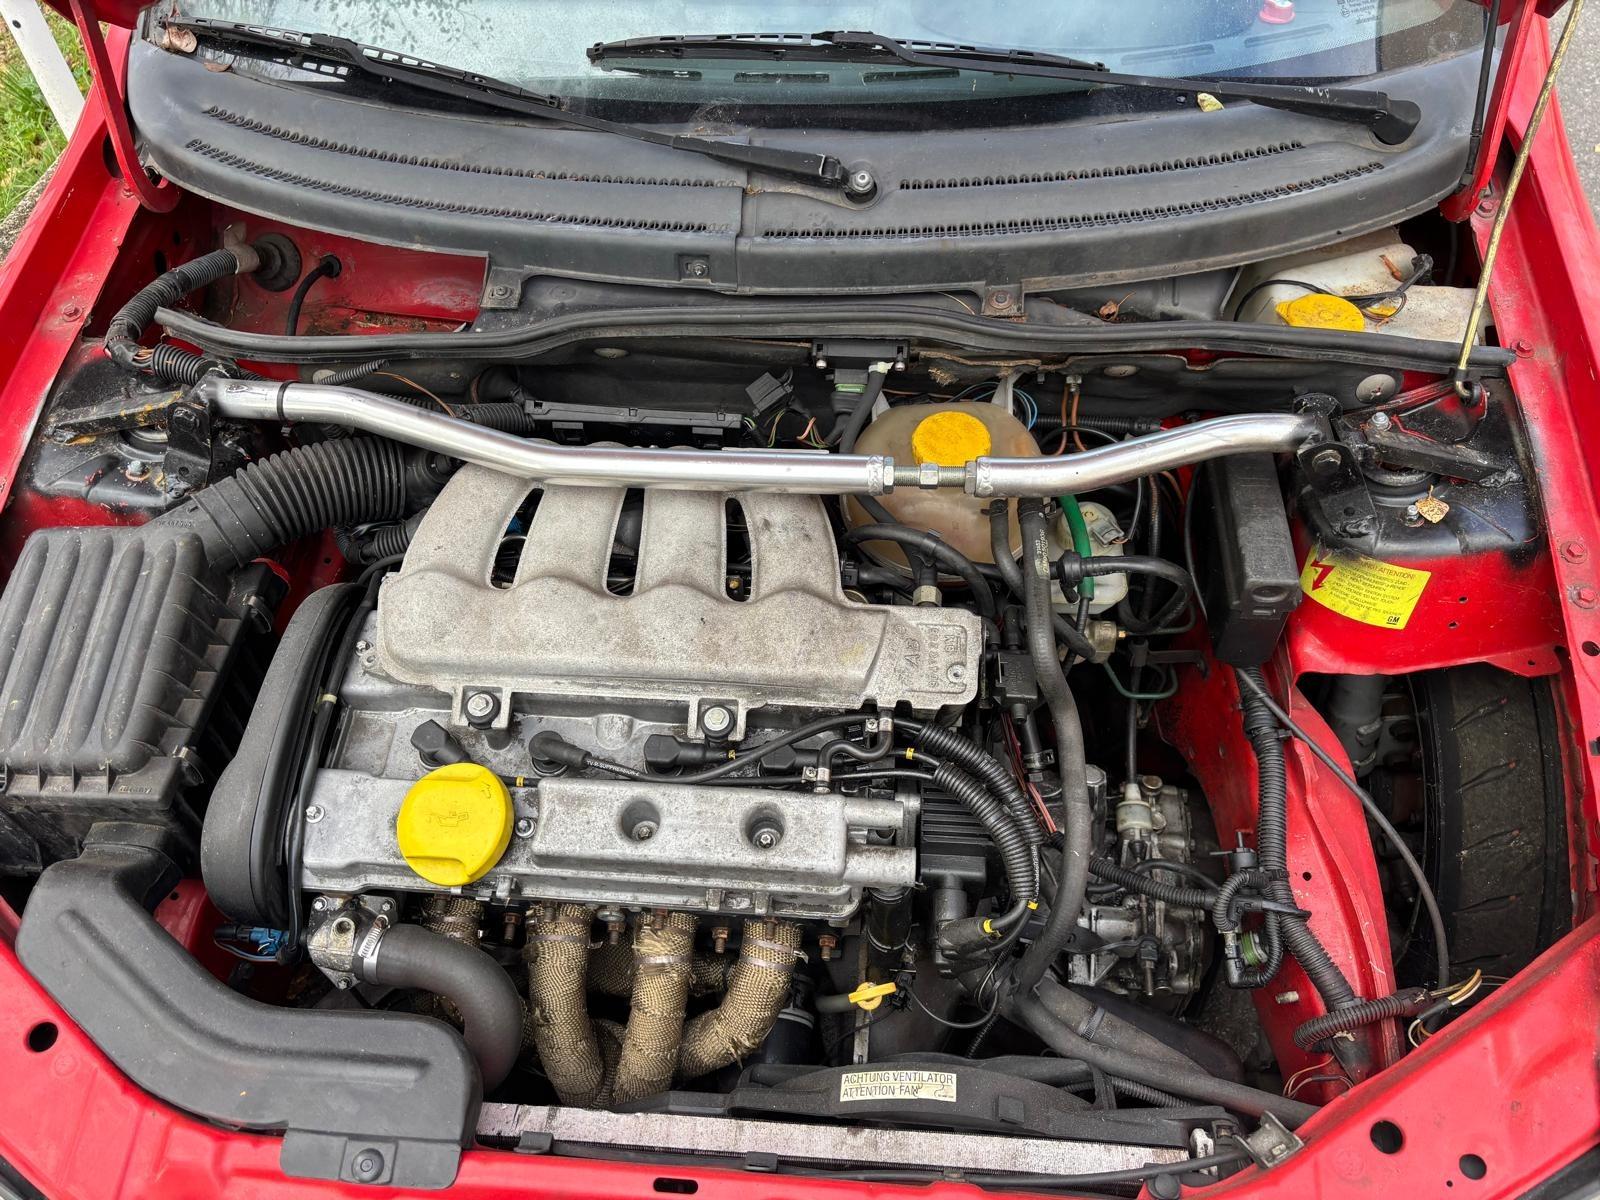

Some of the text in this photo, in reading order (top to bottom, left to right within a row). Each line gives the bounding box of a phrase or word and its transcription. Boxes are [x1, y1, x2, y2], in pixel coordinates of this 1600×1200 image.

[1387, 615, 1400, 624] GM
[843, 1071, 954, 1085] ACHTUNG VENTILATOR
[842, 1085, 919, 1098] ATTENTION FAN
